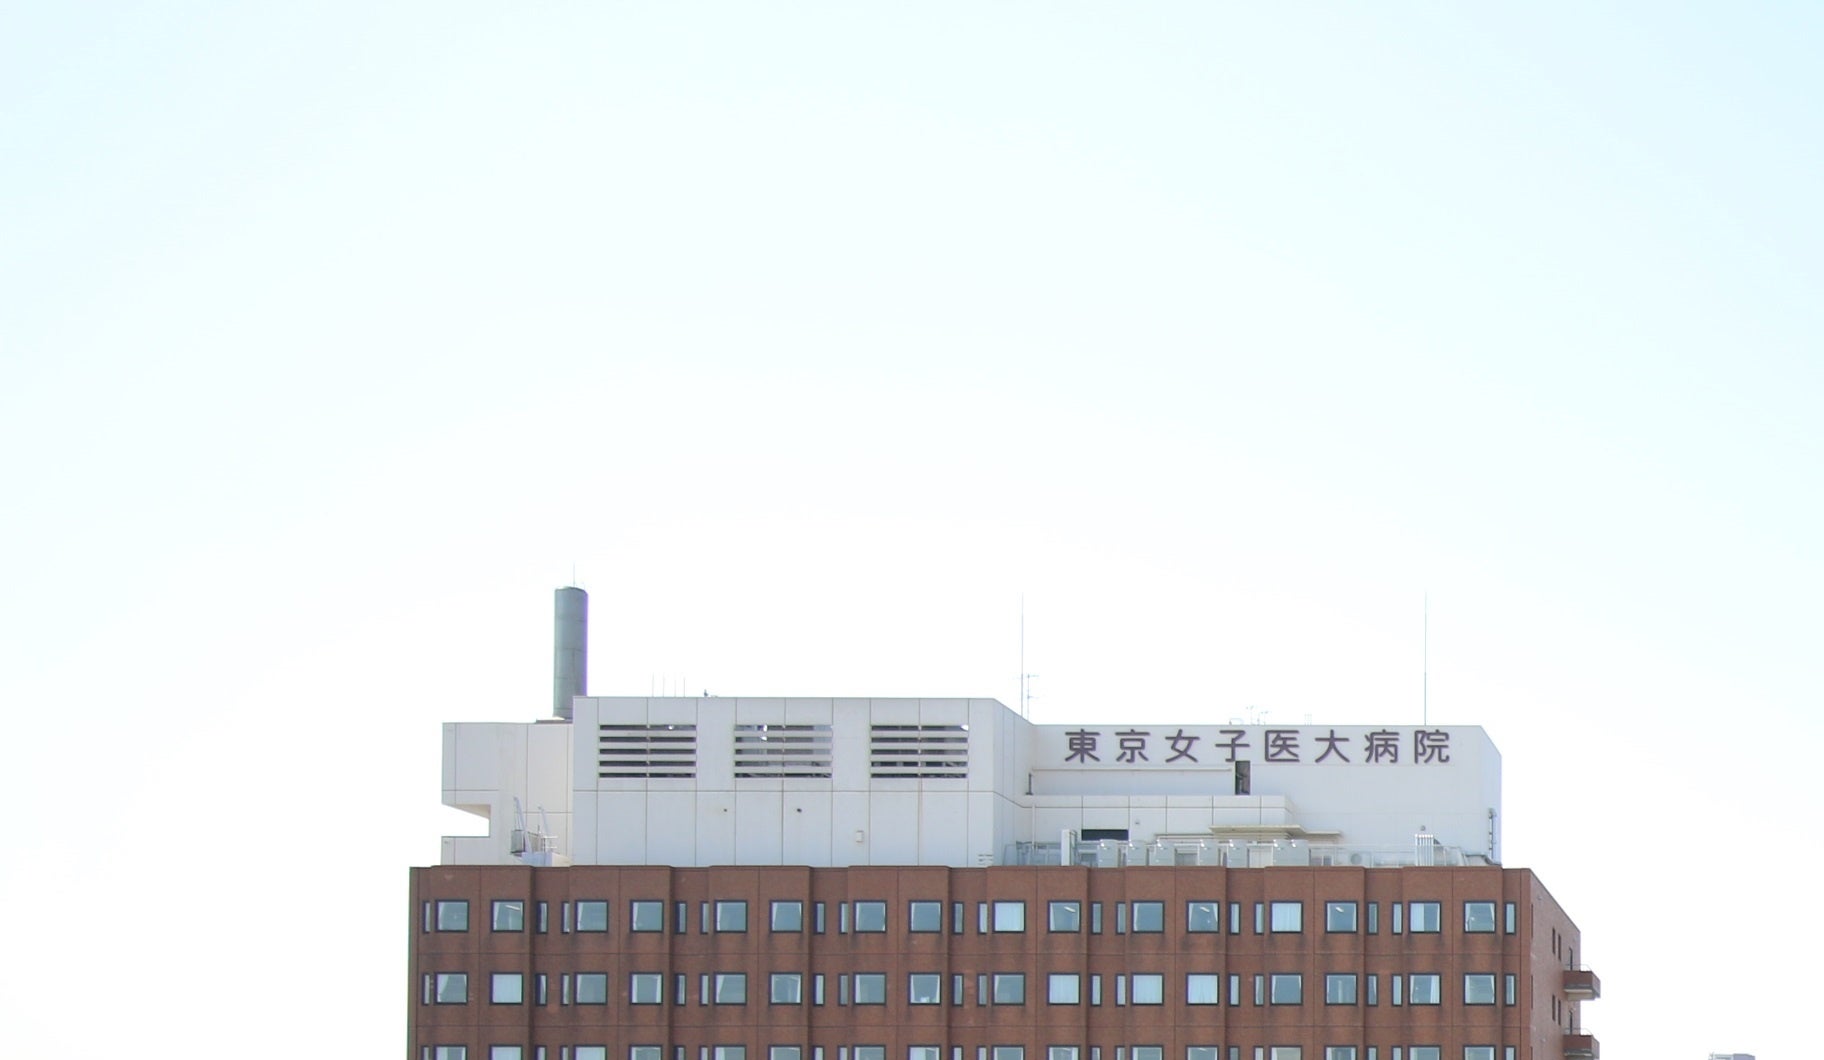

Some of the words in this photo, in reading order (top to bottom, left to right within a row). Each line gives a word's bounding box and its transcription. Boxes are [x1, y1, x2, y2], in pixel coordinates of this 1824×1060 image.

[1064, 729, 1450, 764] 東京女子医大病院
